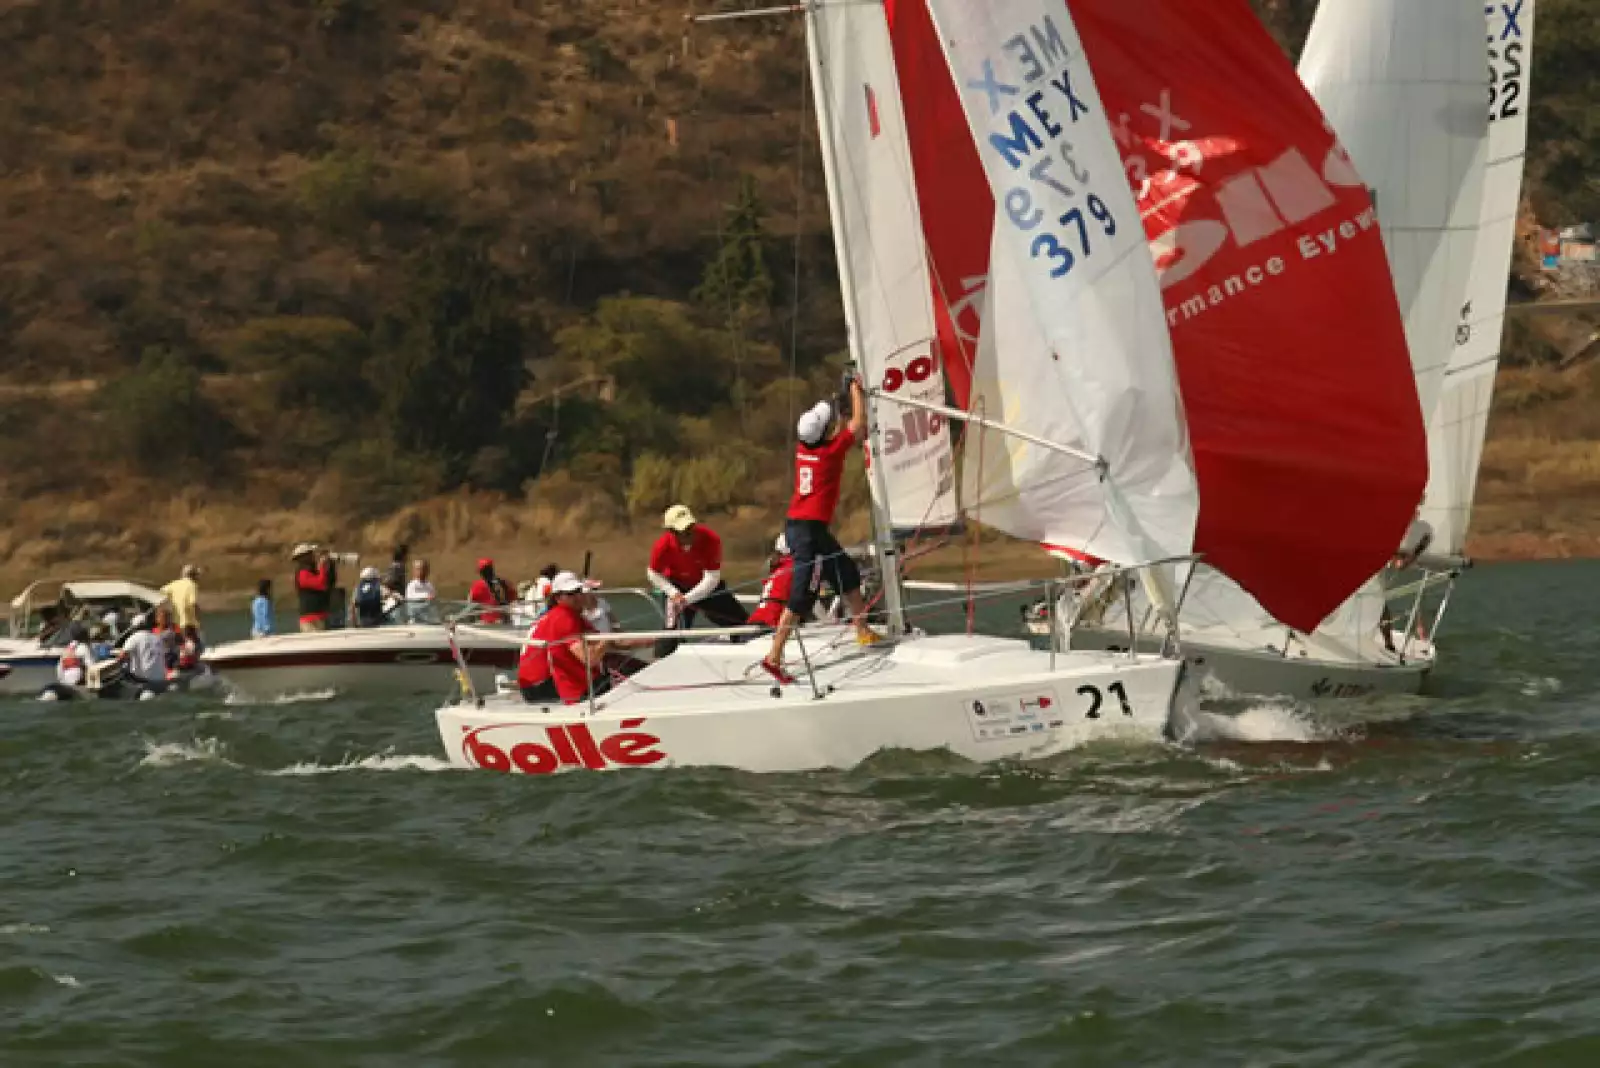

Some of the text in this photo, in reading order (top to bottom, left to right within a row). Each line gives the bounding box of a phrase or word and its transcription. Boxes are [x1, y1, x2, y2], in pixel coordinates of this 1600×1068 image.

[988, 69, 1090, 169] MEX
[1030, 193, 1116, 279] 379
[1075, 680, 1133, 719] 21
[461, 717, 668, 775] bollé
